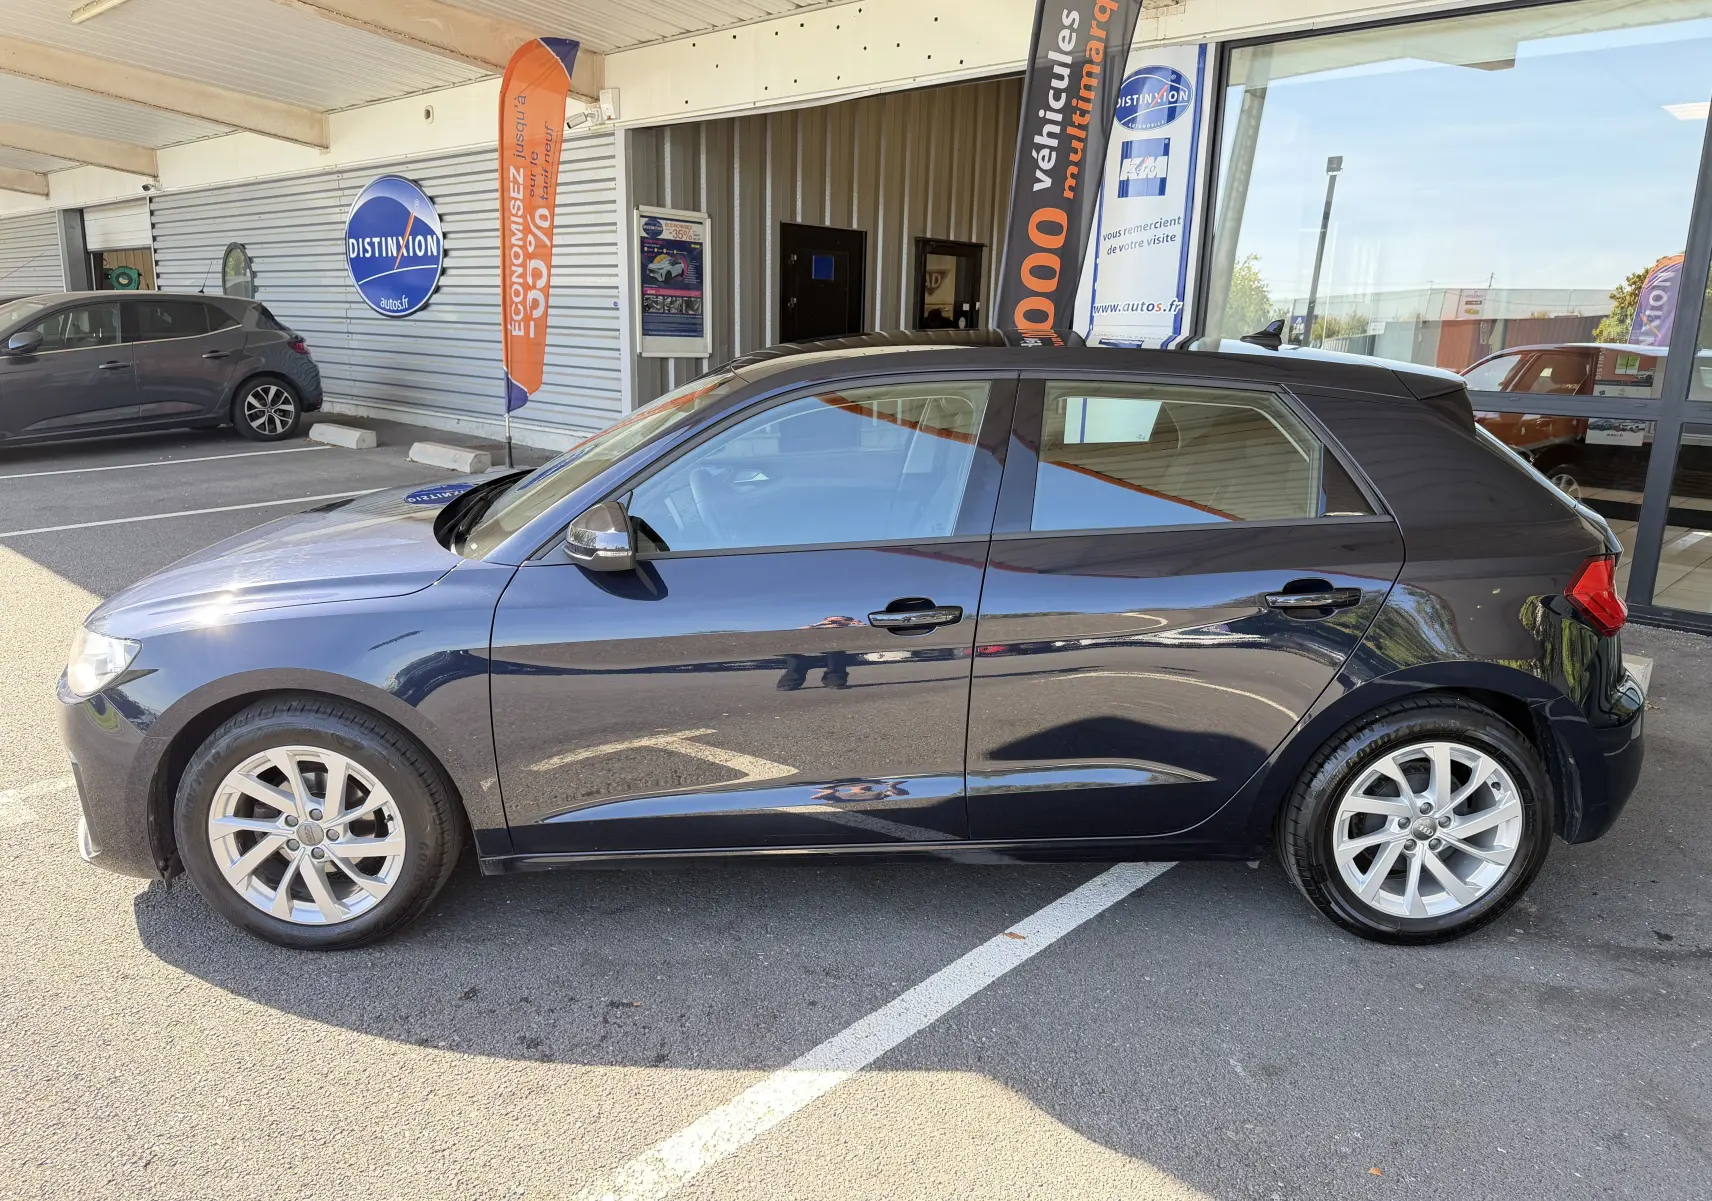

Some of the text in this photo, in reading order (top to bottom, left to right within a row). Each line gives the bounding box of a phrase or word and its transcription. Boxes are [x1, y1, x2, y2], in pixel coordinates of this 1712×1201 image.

[1032, 8, 1080, 192] véhicules
[1063, 0, 1119, 199] multimarq
[530, 150, 539, 166] le
[540, 166, 549, 201] tarif
[508, 95, 527, 337] ÉCONOMISEZ jusqu'à
[1102, 215, 1182, 241] vous remercient
[348, 234, 438, 258] DISTINXION
[1106, 233, 1177, 255] de votre visite
[526, 207, 550, 338] -35%
[380, 295, 409, 311] autos.fr
[1093, 299, 1182, 315] www.autos.fr
